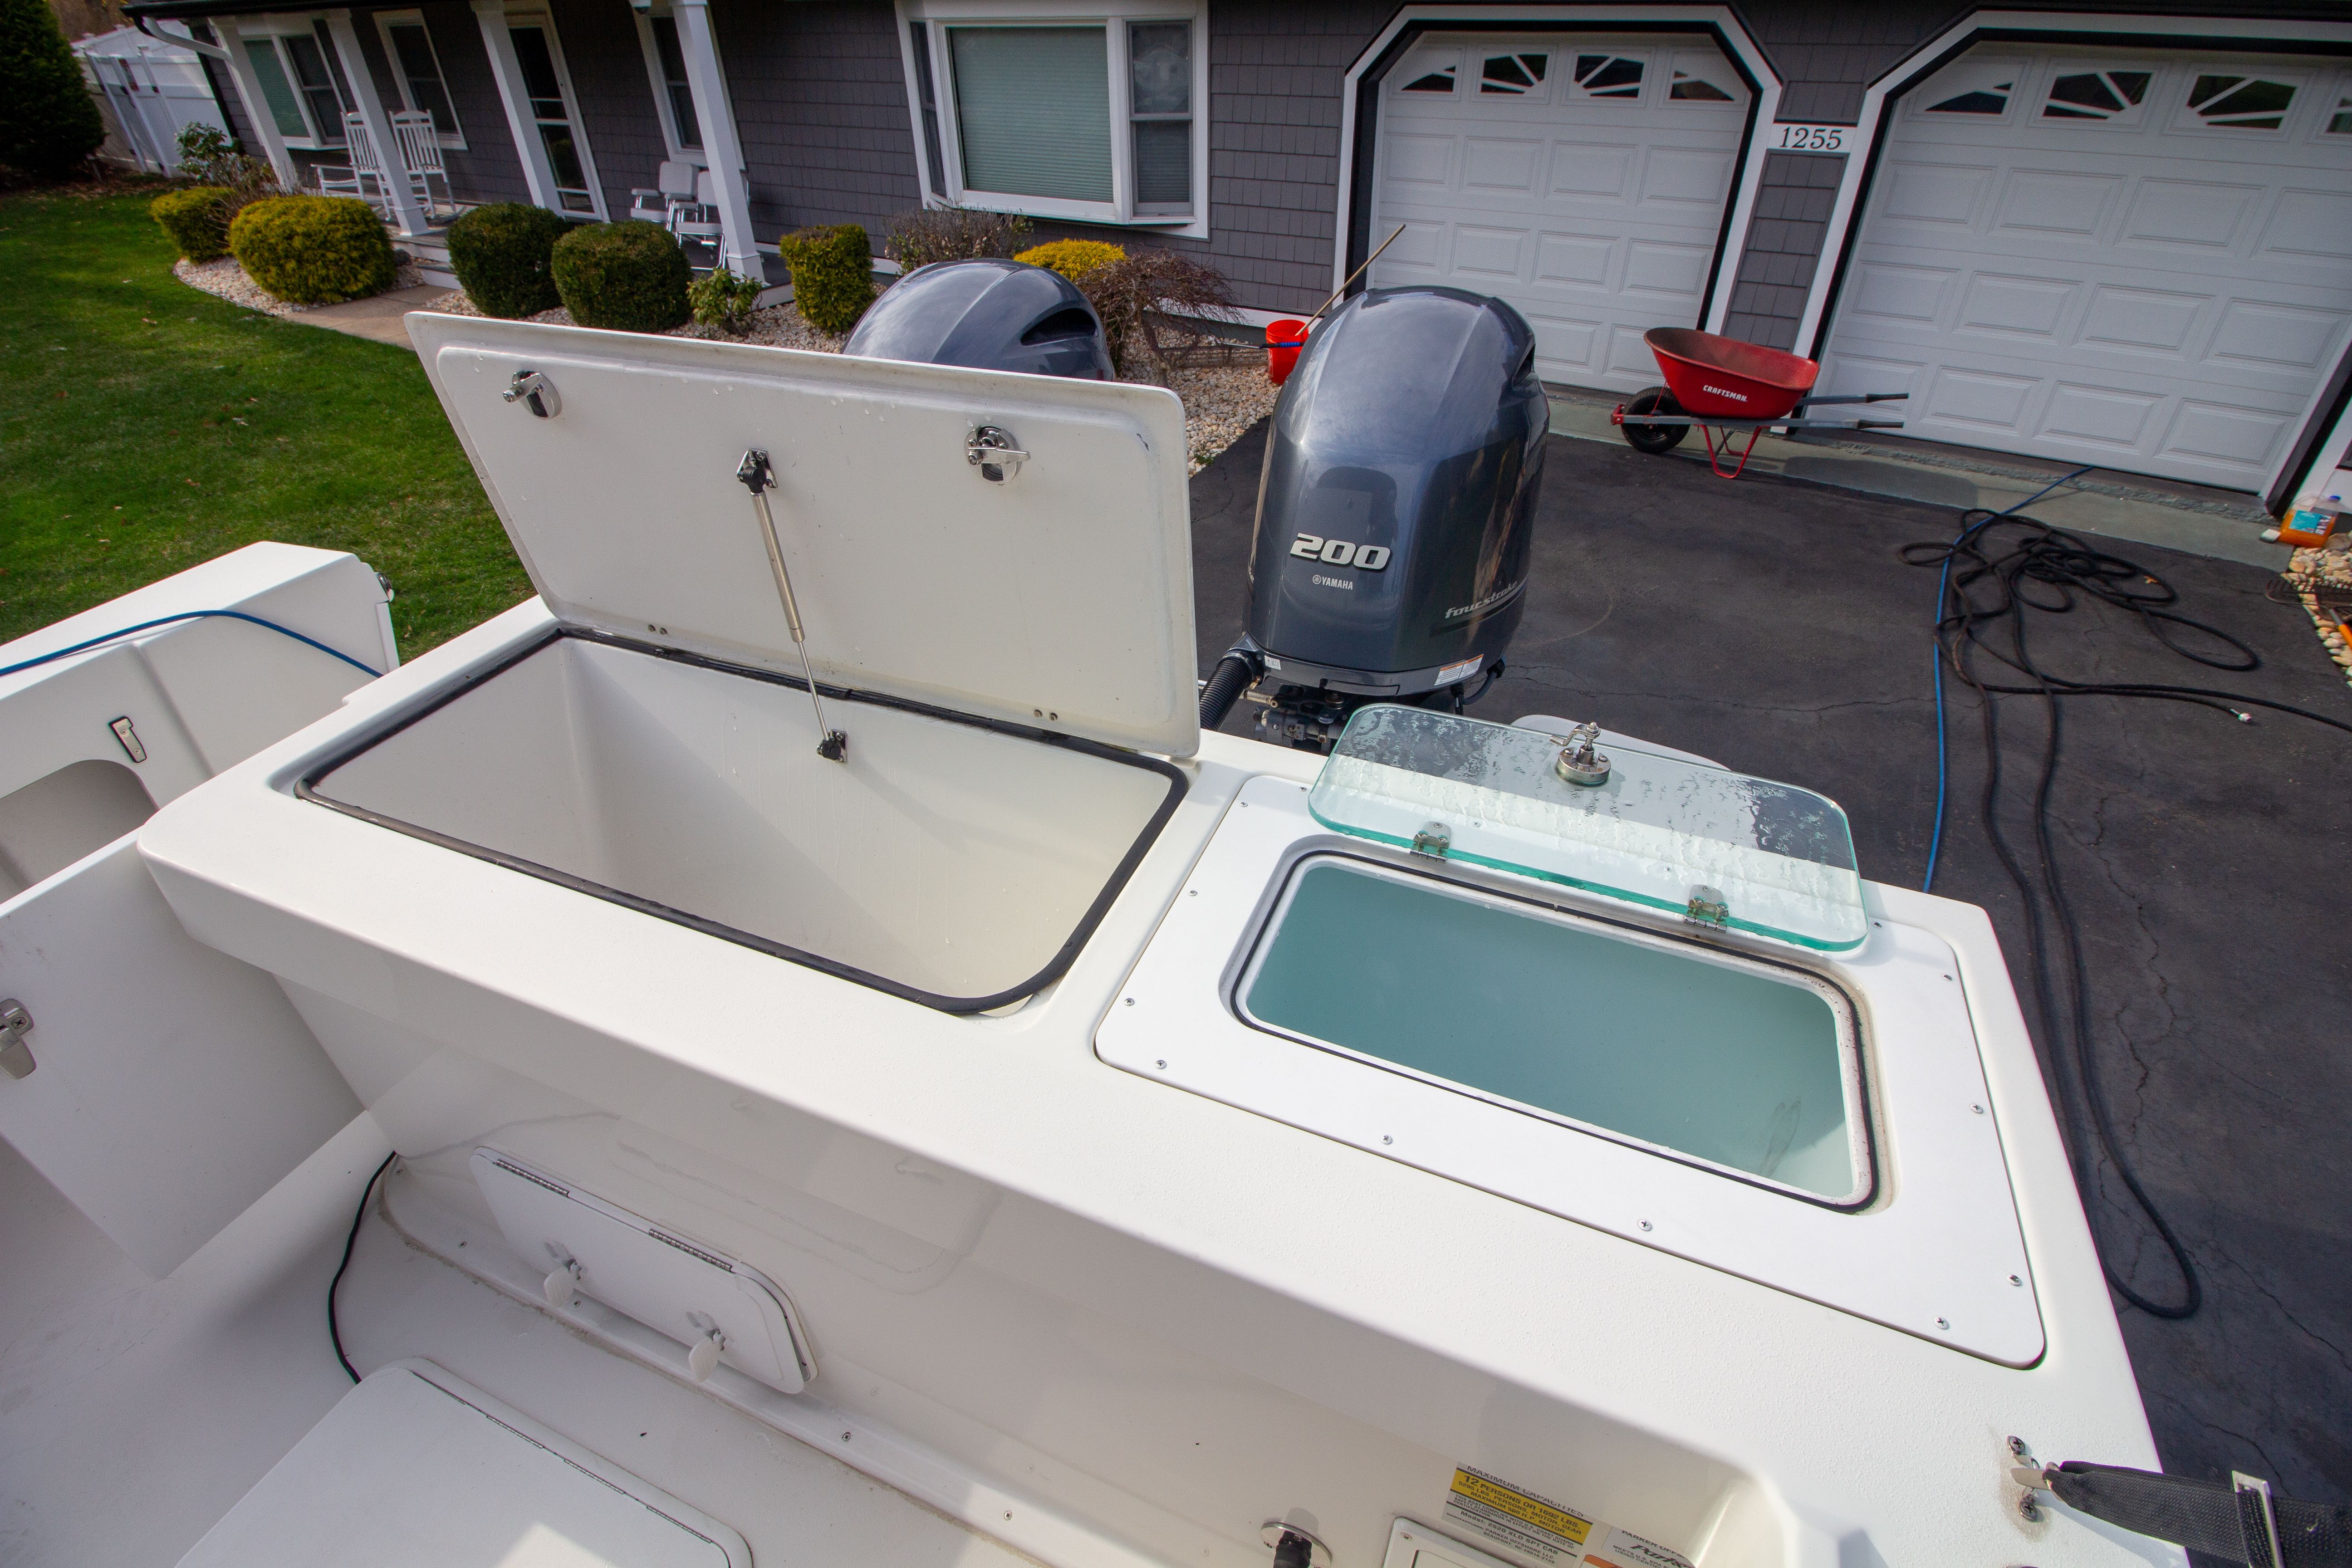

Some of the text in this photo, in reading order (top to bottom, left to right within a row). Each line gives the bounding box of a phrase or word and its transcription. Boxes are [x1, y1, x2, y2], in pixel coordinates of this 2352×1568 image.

[1779, 127, 1842, 150] 1255
[1703, 385, 1747, 402] CRAFTSMAN
[1290, 533, 1391, 570] 200
[1322, 576, 1353, 590] YAMAHA
[1467, 1465, 1519, 1490] MAXIMUM
[1464, 1475, 1580, 1529] 12 PERSONS OR 1692 LBS.
[1470, 1491, 1506, 1509] MAXIMUM
[1539, 1519, 1565, 1533] MOTOR
[1461, 1511, 1558, 1555] Model: 2520 XLD SPT CAB
[1485, 1528, 1508, 1540] PARKER
[1562, 1524, 1582, 1535] GEAR
[1622, 1530, 1658, 1547] PARKER
[1613, 1544, 1634, 1556] MEETS
[1615, 1549, 1634, 1559] USING
